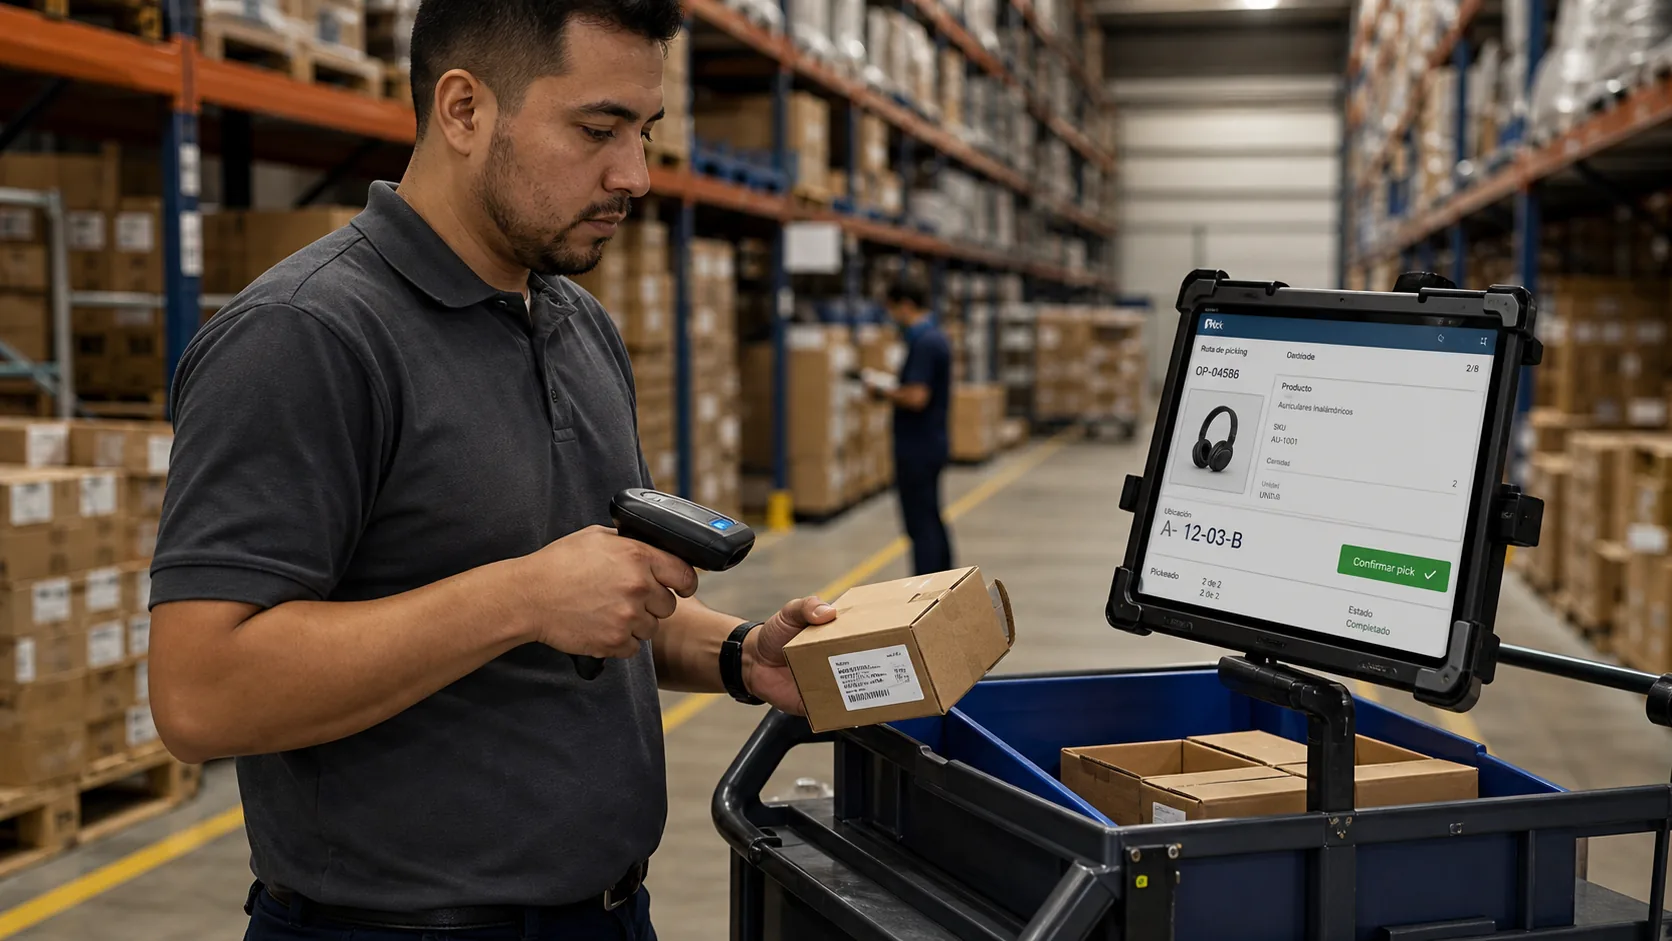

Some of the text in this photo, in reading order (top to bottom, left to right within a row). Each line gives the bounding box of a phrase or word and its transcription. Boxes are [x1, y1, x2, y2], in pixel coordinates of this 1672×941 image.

[1225, 347, 1248, 357] picking
[1195, 366, 1240, 379] OP-04586
[1466, 364, 1480, 373] 2/8
[1281, 382, 1312, 393] Producto
[1271, 436, 1298, 445] AU-1001
[1452, 480, 1458, 488] 2
[1164, 507, 1192, 518] Ubicación
[1184, 523, 1243, 549] 12-03-B
[1353, 557, 1416, 576] Confirmar pick
[1202, 577, 1222, 589] 2 de 2
[1199, 589, 1205, 597] 2
[1215, 592, 1220, 600] 2
[1348, 605, 1373, 618] Estado
[1345, 619, 1391, 636] Completado
